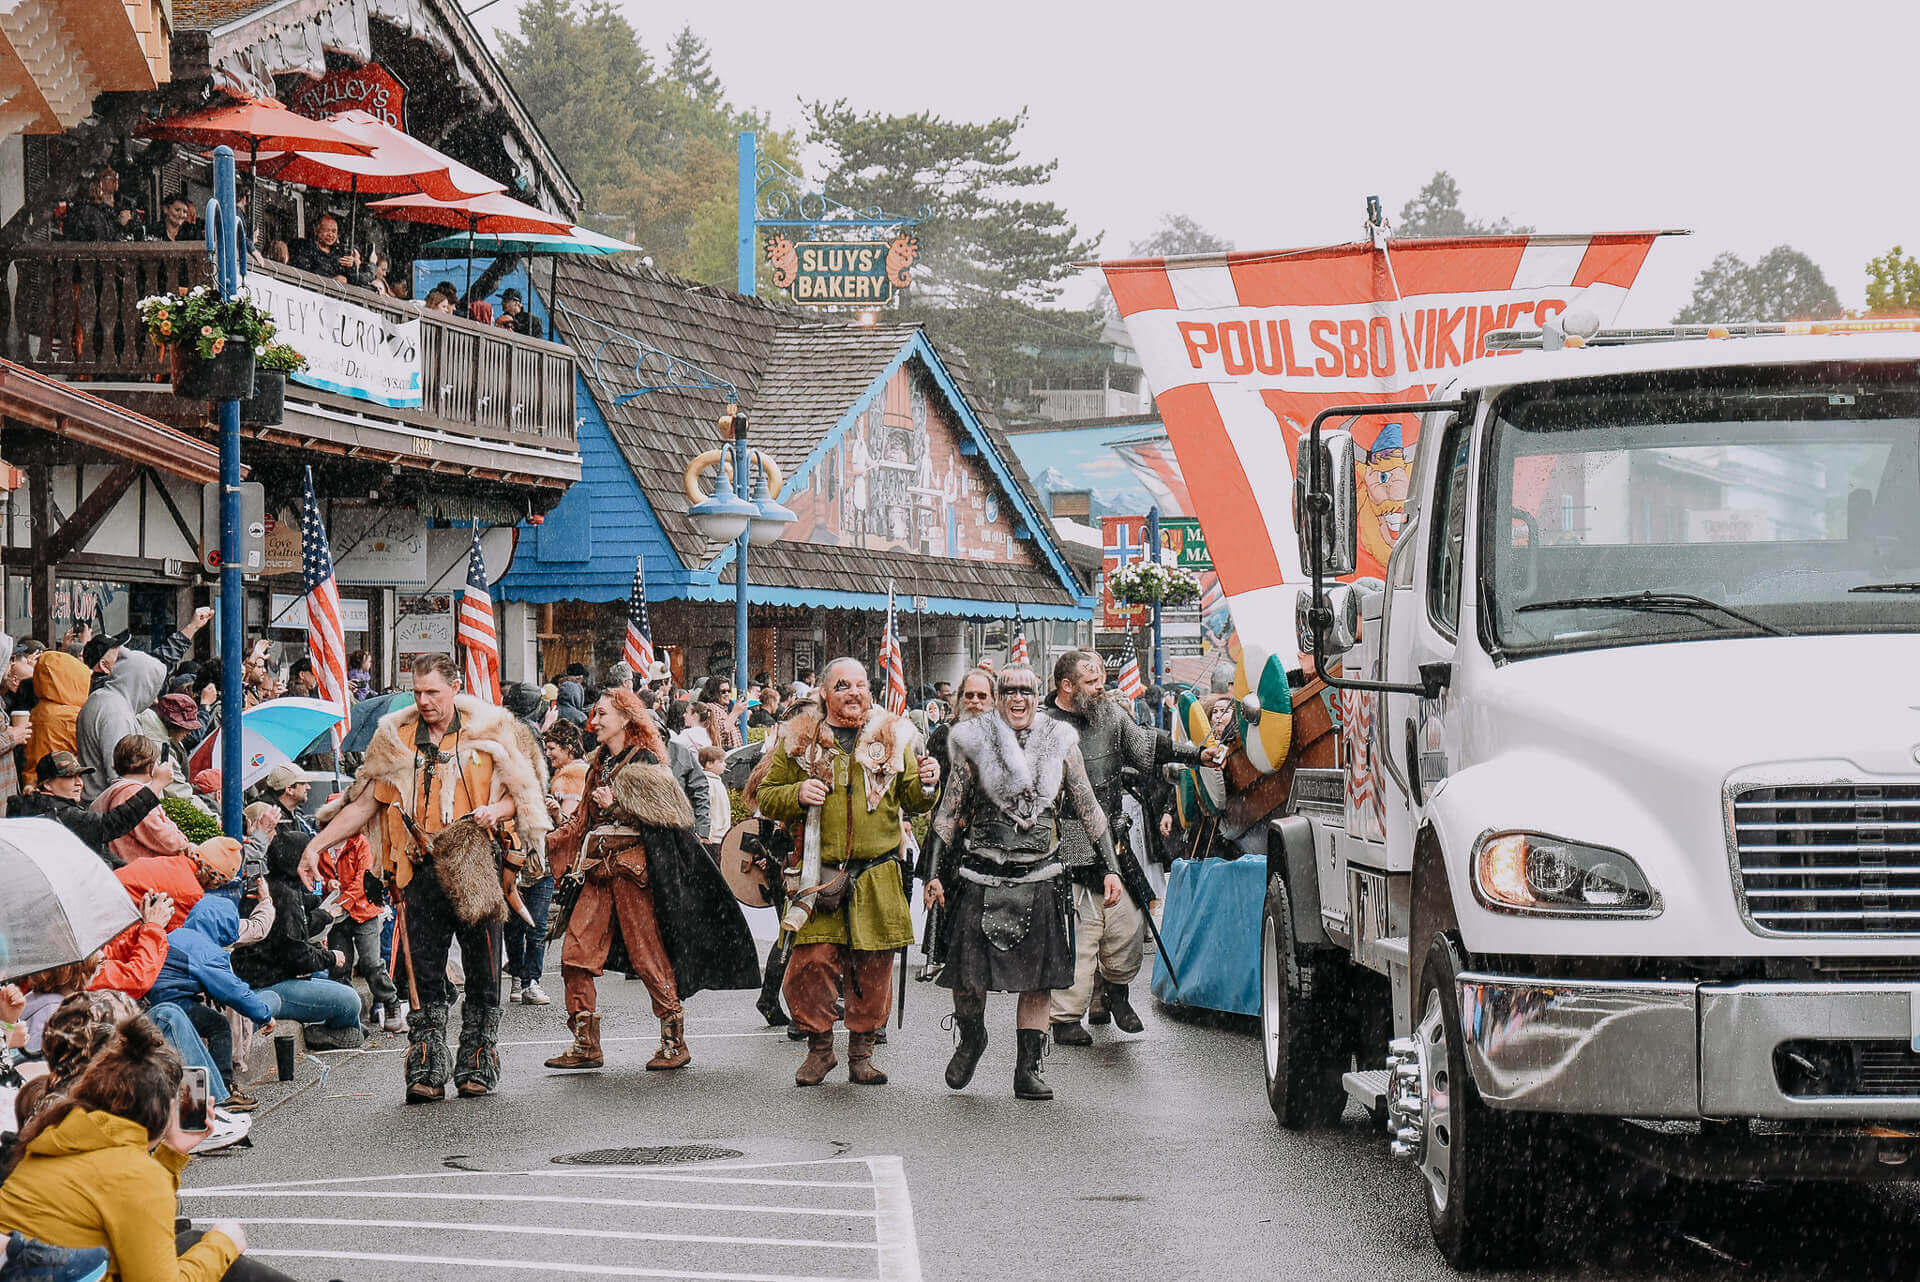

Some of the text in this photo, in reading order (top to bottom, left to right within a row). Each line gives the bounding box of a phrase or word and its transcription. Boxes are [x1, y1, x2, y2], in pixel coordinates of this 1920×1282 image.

[802, 249, 882, 273] SLUYS'
[798, 275, 885, 298] BAKERY
[1176, 315, 1396, 378] POULSBO
[1186, 548, 1211, 561] MA
